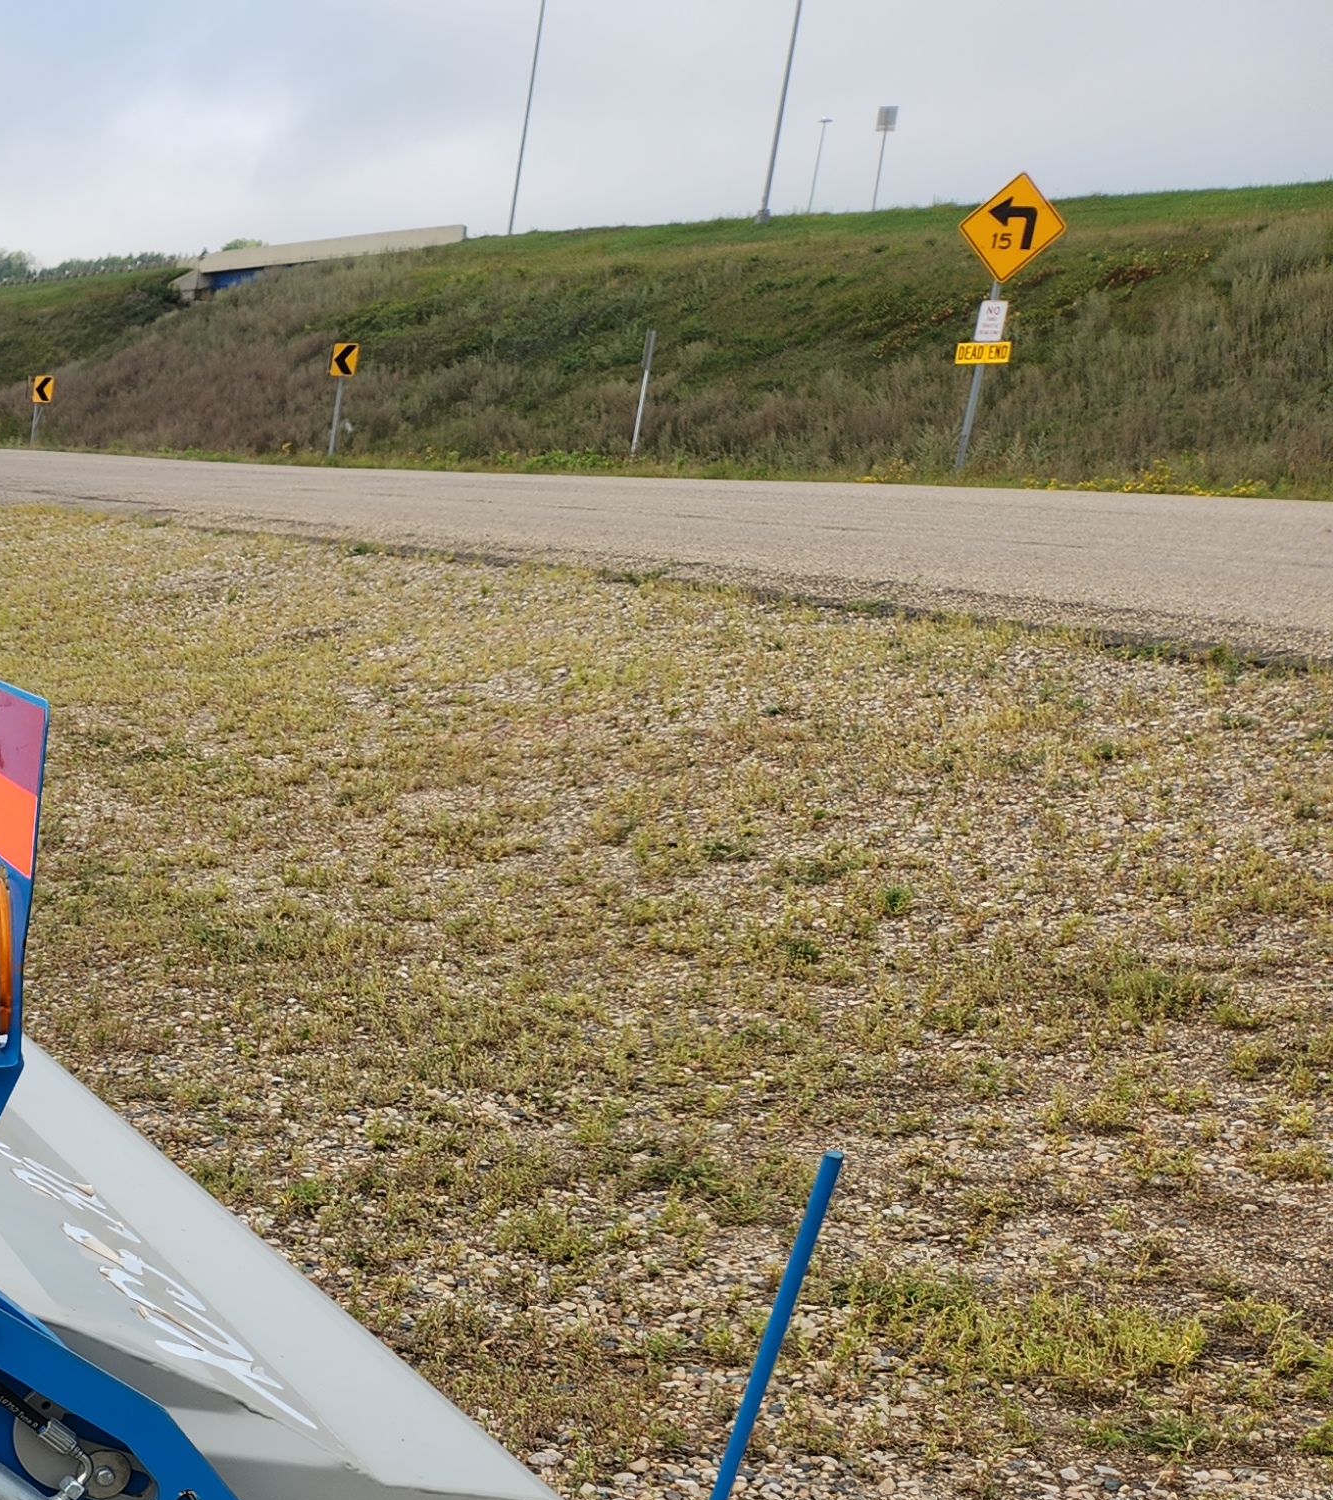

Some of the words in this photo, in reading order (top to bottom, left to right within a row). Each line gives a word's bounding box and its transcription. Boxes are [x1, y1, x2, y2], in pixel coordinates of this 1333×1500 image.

[991, 232, 1012, 250] 15
[986, 305, 1001, 315] NO
[958, 346, 984, 360] DEAD
[988, 345, 1008, 359] END
